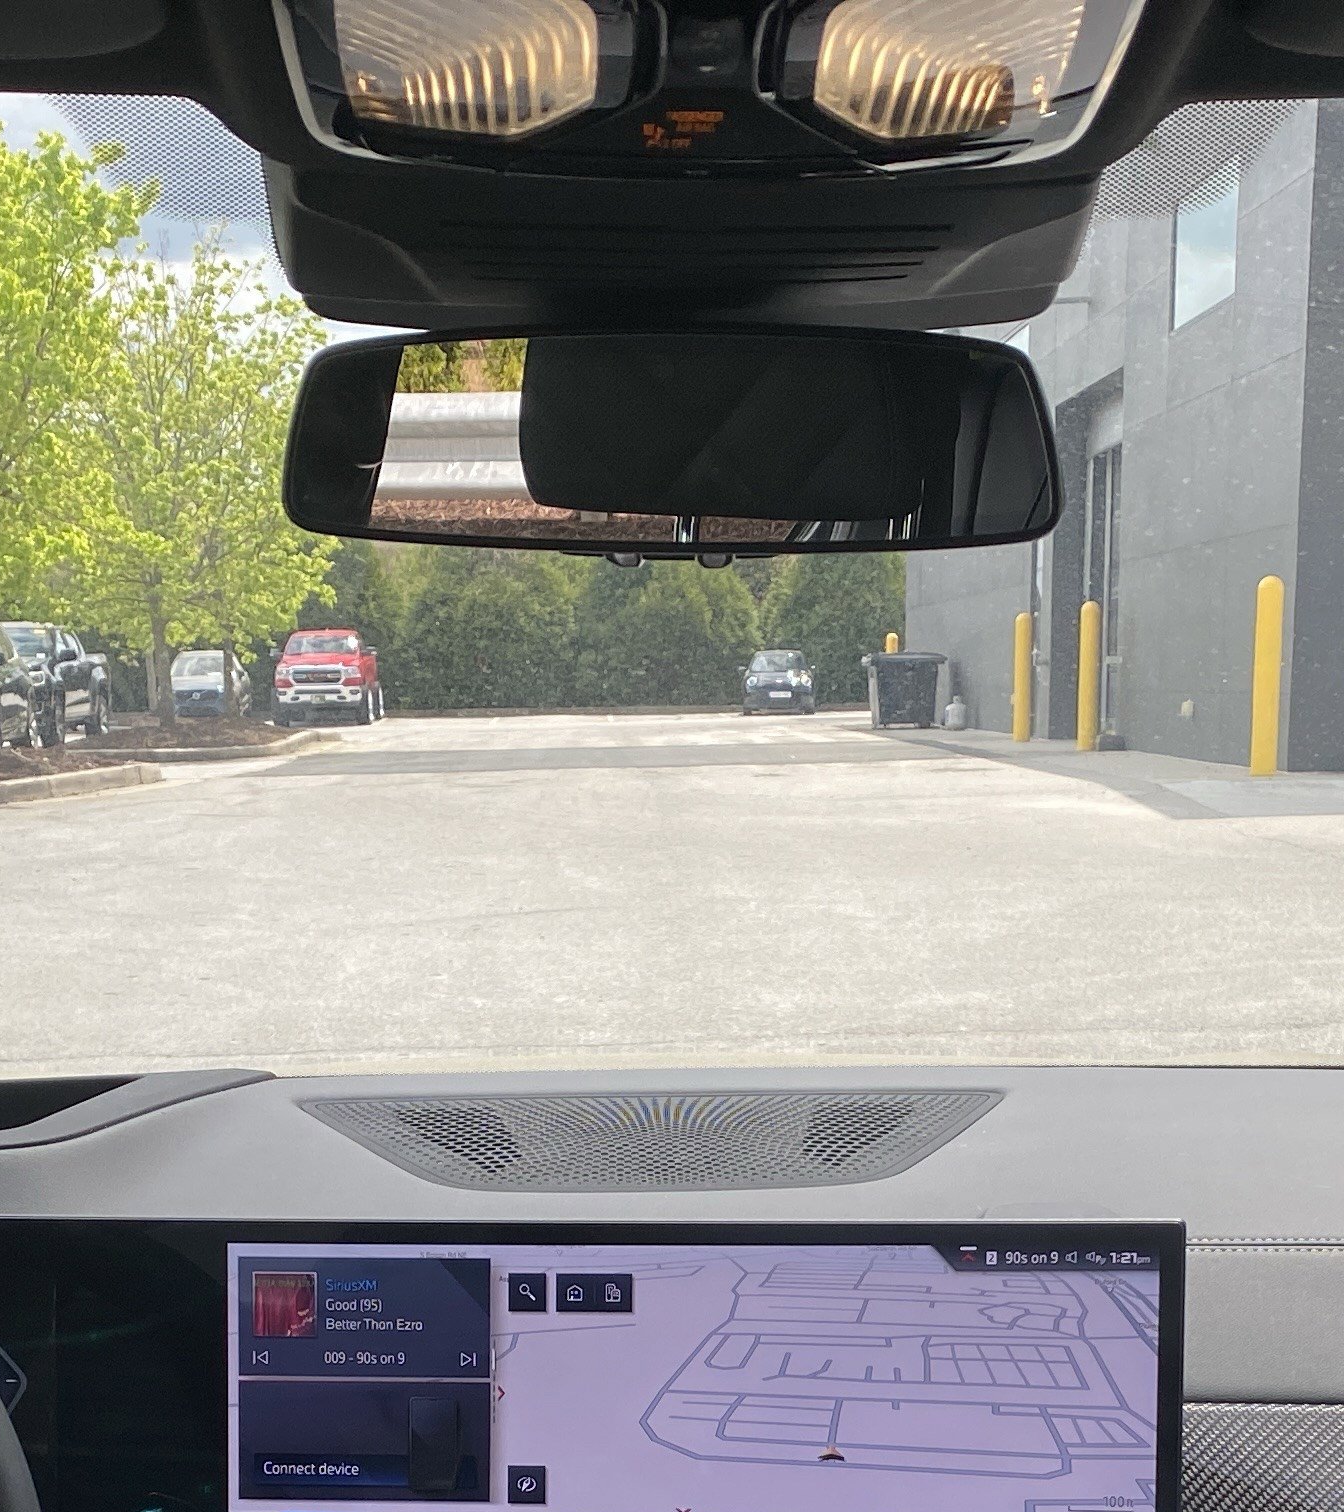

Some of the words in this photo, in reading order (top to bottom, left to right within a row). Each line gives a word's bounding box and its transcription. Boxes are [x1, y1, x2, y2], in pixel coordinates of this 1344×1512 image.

[1005, 1252, 1028, 1264] 90s
[1031, 1254, 1047, 1264] on
[1050, 1252, 1058, 1264] 9
[325, 1278, 378, 1292] SiriusXM
[325, 1298, 357, 1312] Good
[325, 1318, 362, 1331] Better
[364, 1318, 394, 1331] Than
[396, 1318, 423, 1331] Ezra
[324, 1350, 346, 1364] 009
[356, 1351, 378, 1365] 90s
[380, 1355, 395, 1364] on
[397, 1352, 406, 1365] 9
[263, 1461, 316, 1476] Connect
[318, 1462, 360, 1476] device
[1102, 1496, 1124, 1508] 100
